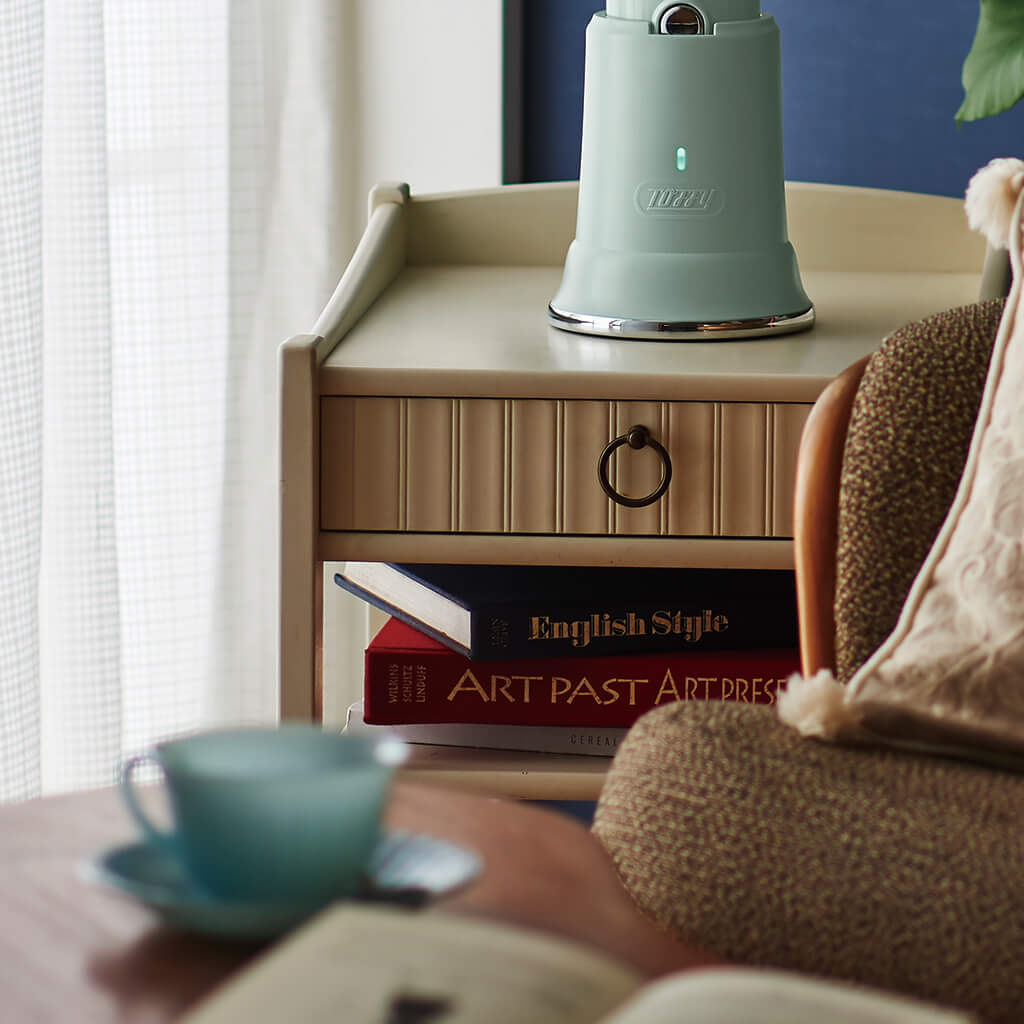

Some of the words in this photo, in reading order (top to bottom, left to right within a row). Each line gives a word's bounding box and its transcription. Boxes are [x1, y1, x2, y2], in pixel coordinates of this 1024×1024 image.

[527, 612, 646, 647] English
[651, 610, 729, 643] Style
[447, 668, 543, 703] ART
[551, 676, 648, 705] PAST
[654, 667, 717, 705] ART
